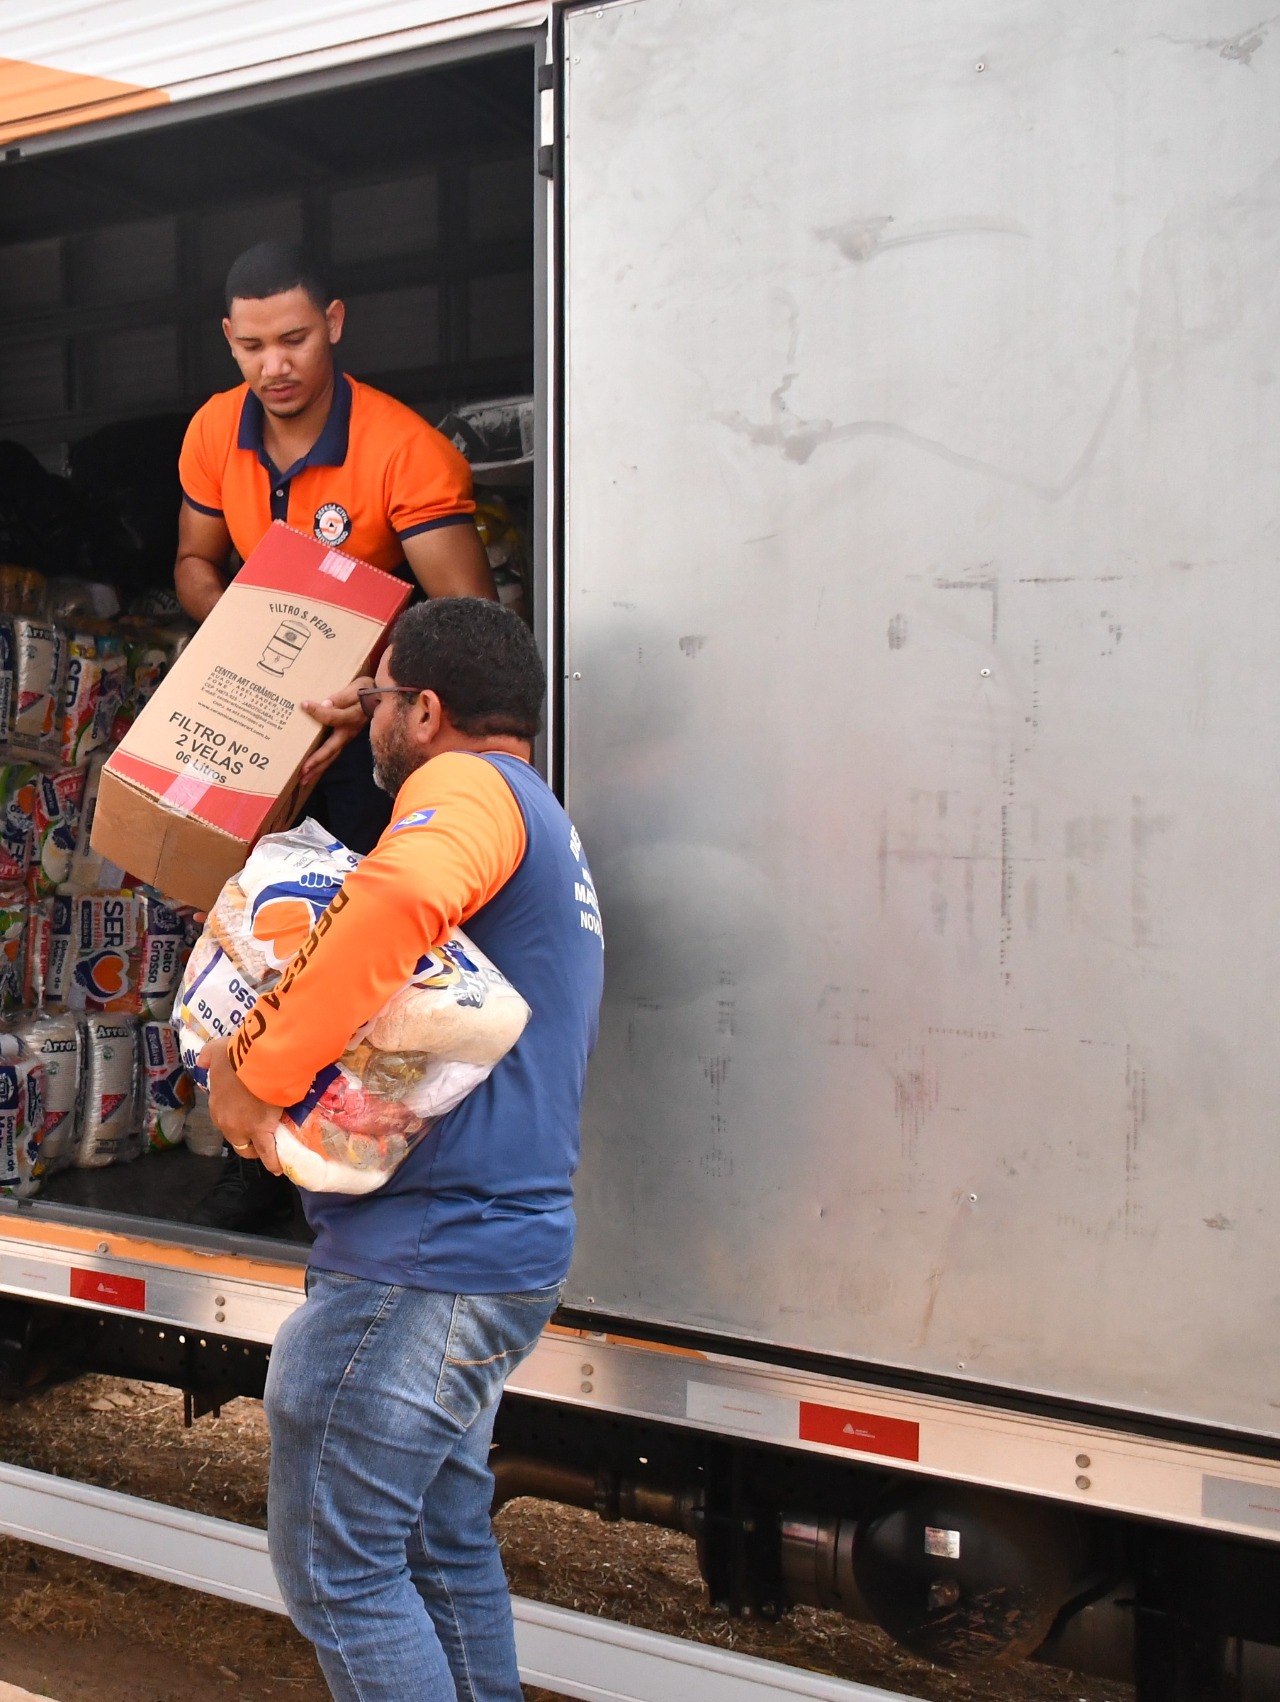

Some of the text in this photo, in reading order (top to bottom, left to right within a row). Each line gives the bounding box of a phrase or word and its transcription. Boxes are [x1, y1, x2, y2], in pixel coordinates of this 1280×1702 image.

[269, 603, 336, 640] FILTRO S. PEDRO
[207, 676, 227, 690] FONE
[214, 665, 238, 681] CENTER
[237, 676, 250, 687] ART
[168, 711, 227, 747] FILTRO
[227, 740, 249, 756] Nº
[248, 752, 270, 771] 02
[175, 733, 244, 775] 2 VELAS
[175, 751, 227, 784] 06 Litros
[104, 900, 124, 948] SER
[148, 940, 163, 984] Grosso
[162, 940, 175, 973] Mato
[198, 999, 213, 1020] de
[228, 978, 258, 1011] sso
[7, 1115, 16, 1172] Governo de
